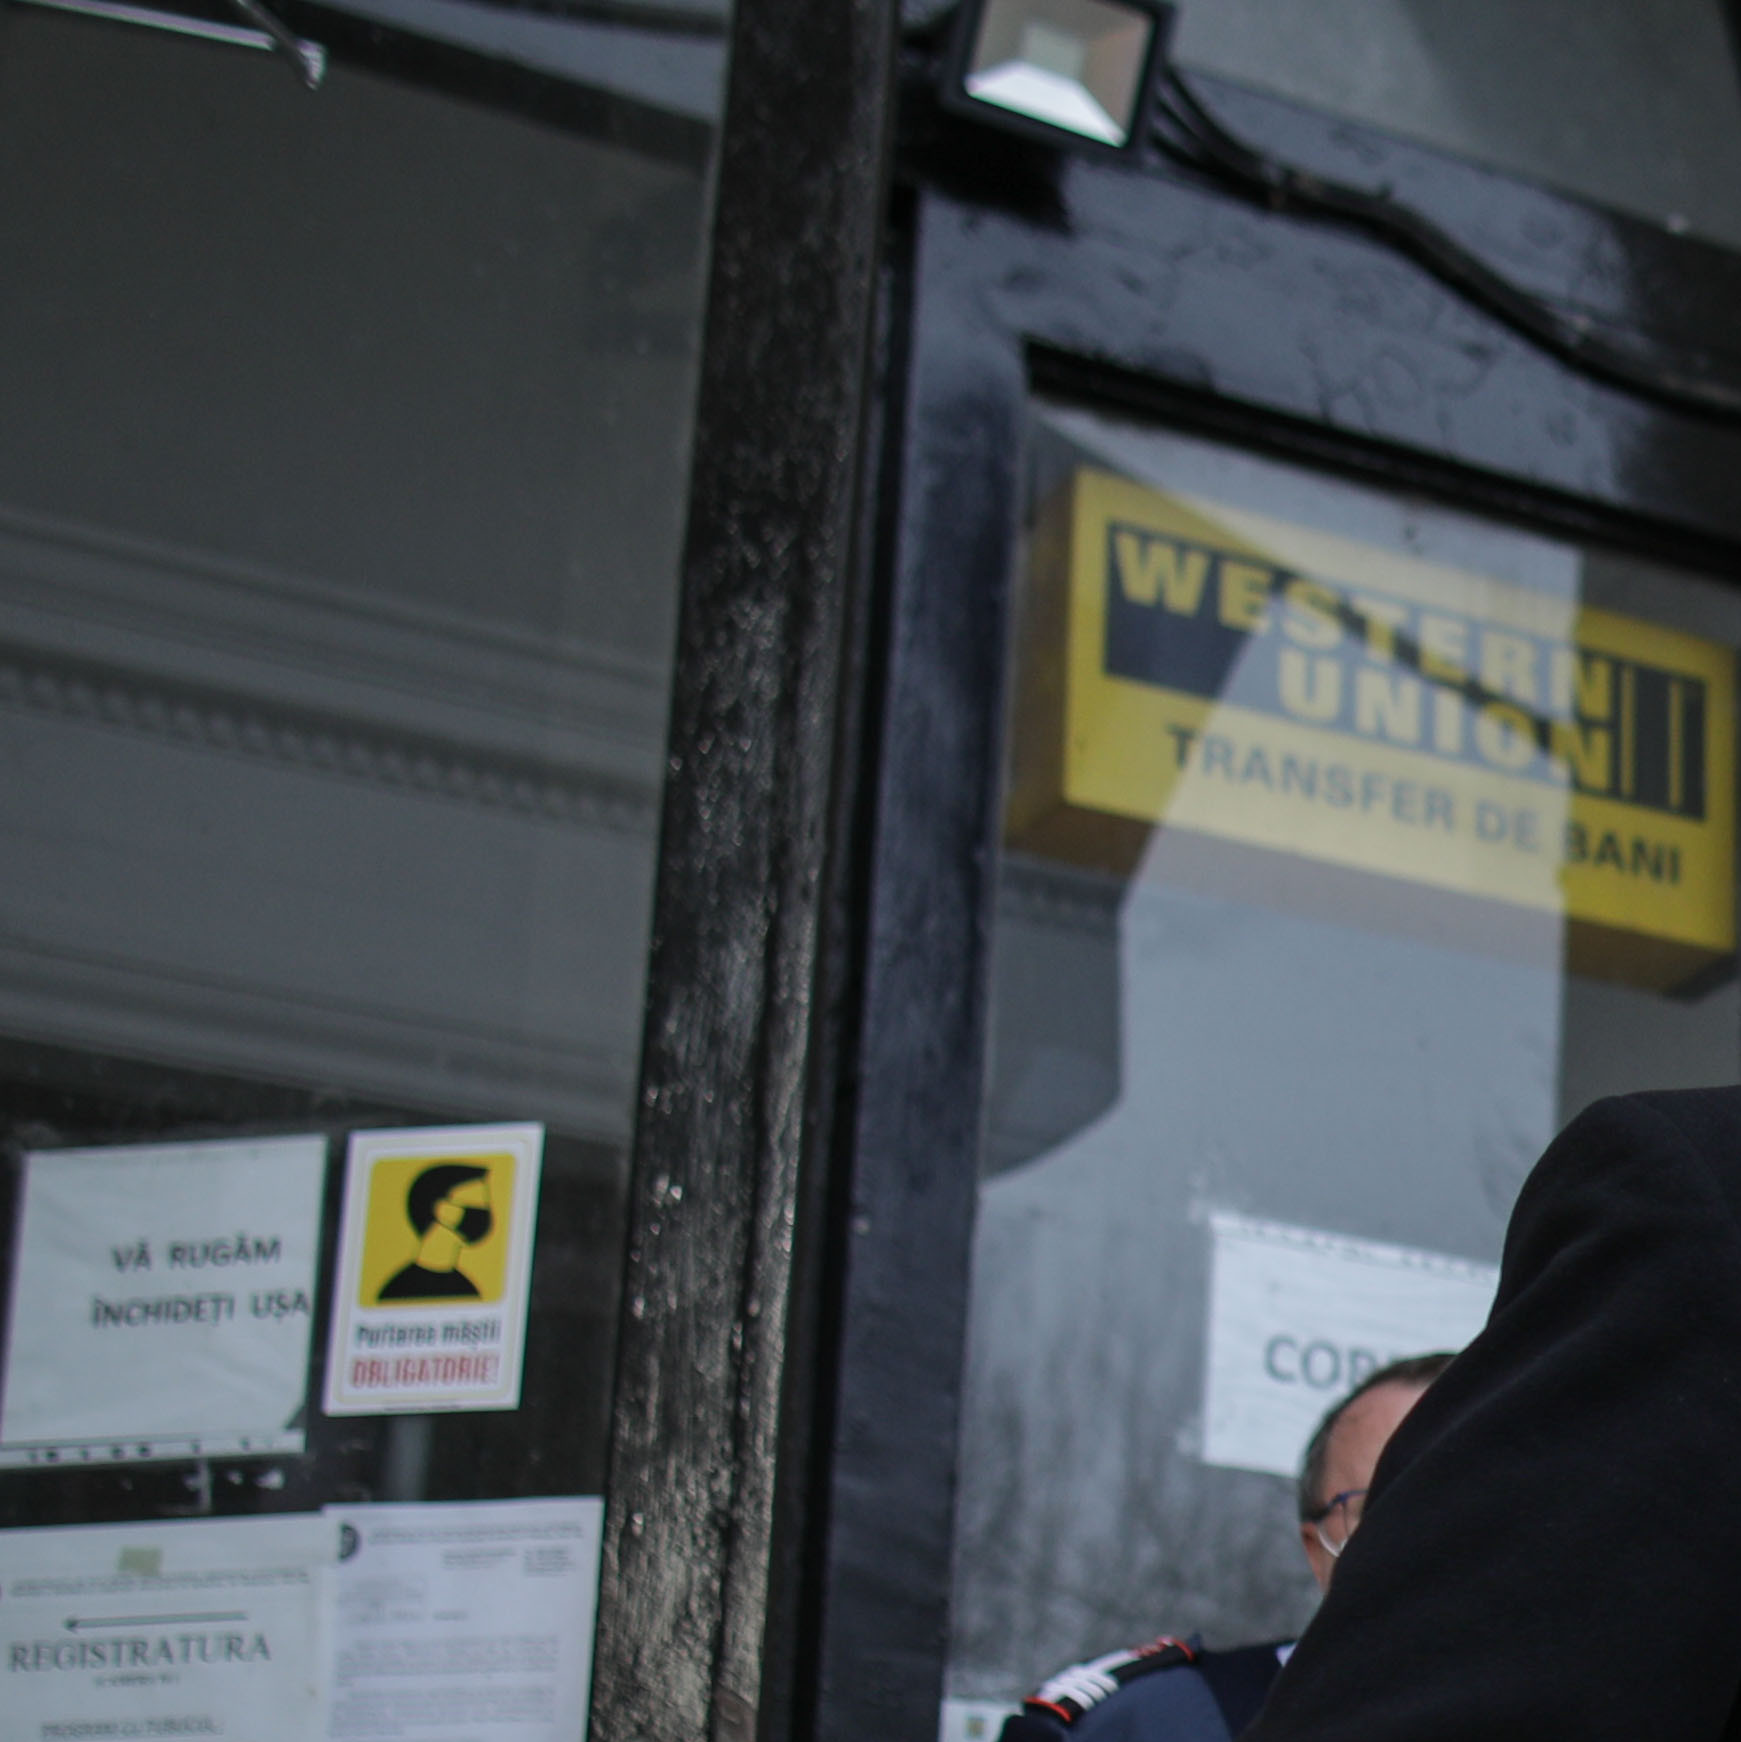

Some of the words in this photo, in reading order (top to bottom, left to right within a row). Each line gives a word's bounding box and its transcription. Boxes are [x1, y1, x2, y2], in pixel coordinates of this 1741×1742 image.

[1114, 532, 1613, 718] WESTERN
[1279, 651, 1613, 793] UNION
[1167, 723, 1456, 833] TRANSFER
[1476, 799, 1540, 853] DE
[1563, 819, 1682, 886] BANI
[8, 1633, 272, 1673] REGISTRATURA
